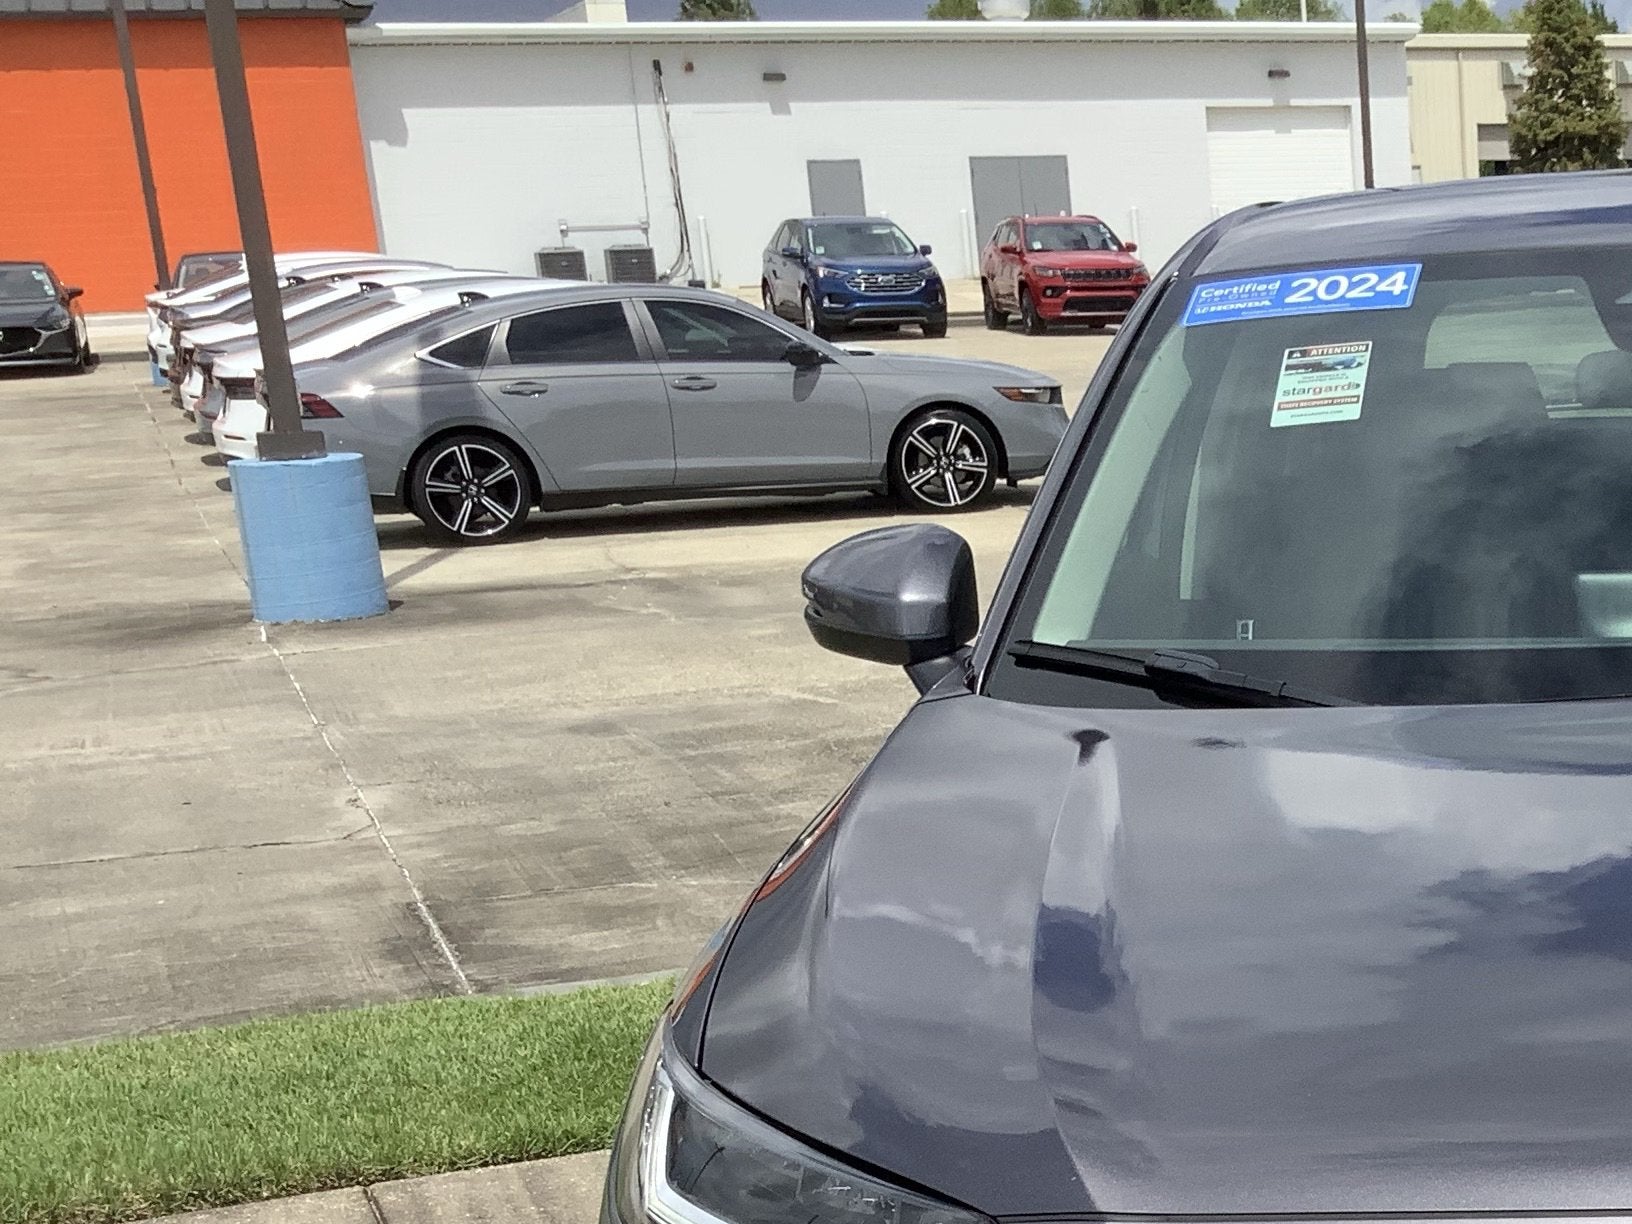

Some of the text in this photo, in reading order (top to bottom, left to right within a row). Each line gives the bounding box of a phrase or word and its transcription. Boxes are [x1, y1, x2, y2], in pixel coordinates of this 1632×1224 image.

[1201, 280, 1281, 298] Certified
[1284, 271, 1408, 304] 2024
[1310, 344, 1367, 357] ATTENTION
